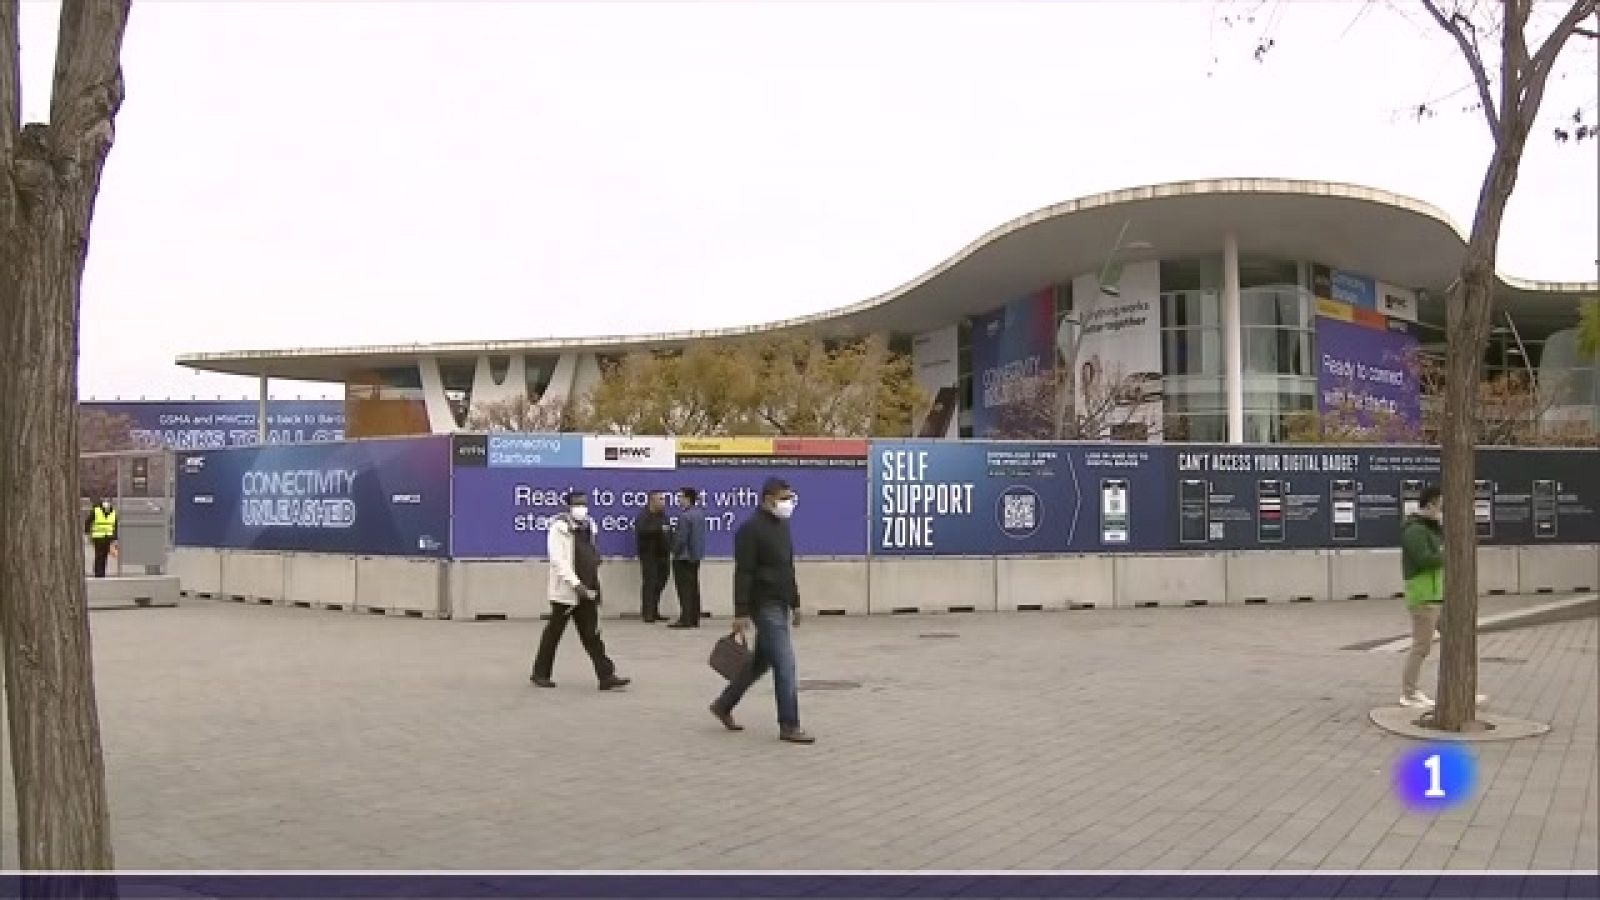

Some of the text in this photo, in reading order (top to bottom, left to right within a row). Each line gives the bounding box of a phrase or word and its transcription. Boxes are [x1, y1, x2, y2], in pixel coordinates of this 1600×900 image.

[192, 414, 213, 425] and
[490, 437, 561, 452] Connecting
[619, 446, 651, 459] MWC
[491, 452, 541, 465] Startups
[882, 451, 929, 481] SELF
[1179, 453, 1358, 471] CAN'T ACCESS YOUR DIGITAL BADGE?
[242, 470, 357, 495] CONNECTIVITY
[592, 487, 614, 506] to
[715, 487, 757, 506] with
[882, 483, 975, 515] SUPPORT
[242, 499, 356, 527] UNLEASHED
[882, 516, 934, 548] ZONE
